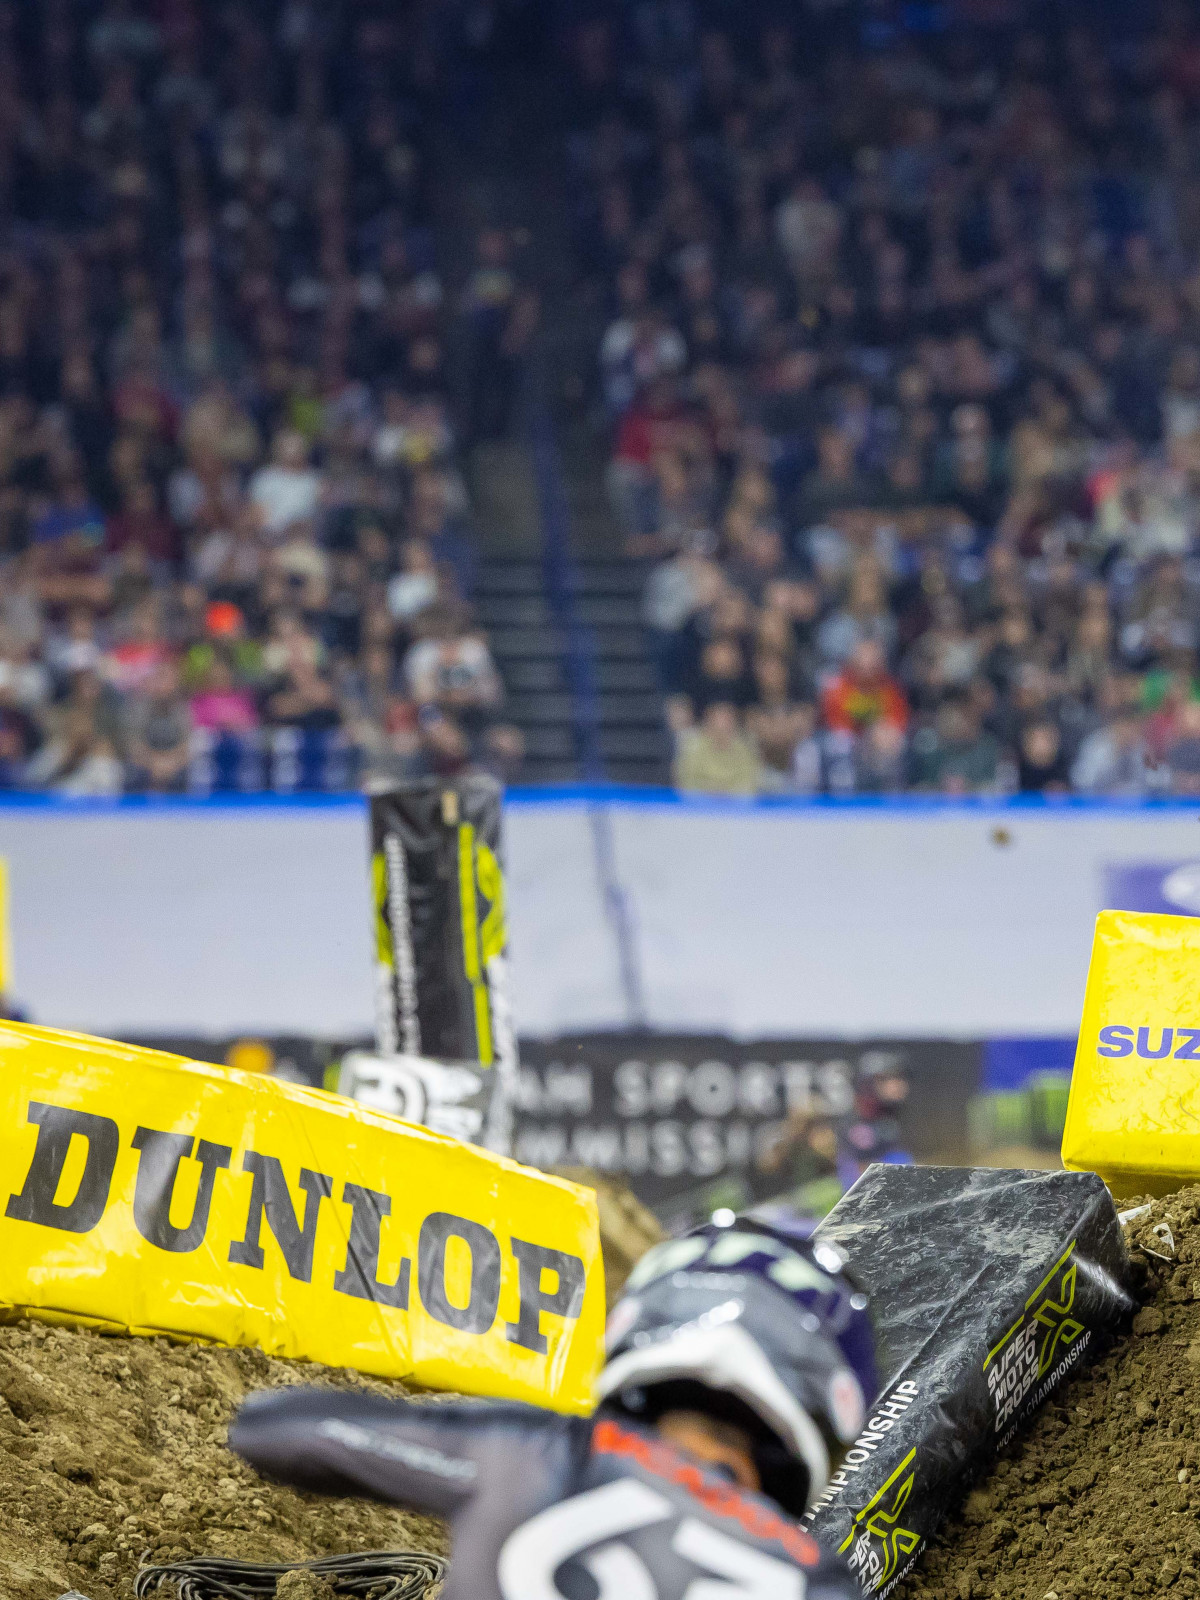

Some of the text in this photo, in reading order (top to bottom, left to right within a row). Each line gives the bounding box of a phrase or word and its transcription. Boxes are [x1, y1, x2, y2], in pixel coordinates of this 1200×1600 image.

[5, 1100, 587, 1356] DUNLOP
[987, 1318, 1039, 1397] SUPER
[995, 1339, 1036, 1411] MOTO
[995, 1356, 1039, 1433] CROSS
[1026, 1330, 1092, 1415] CHAMPIONSHIP
